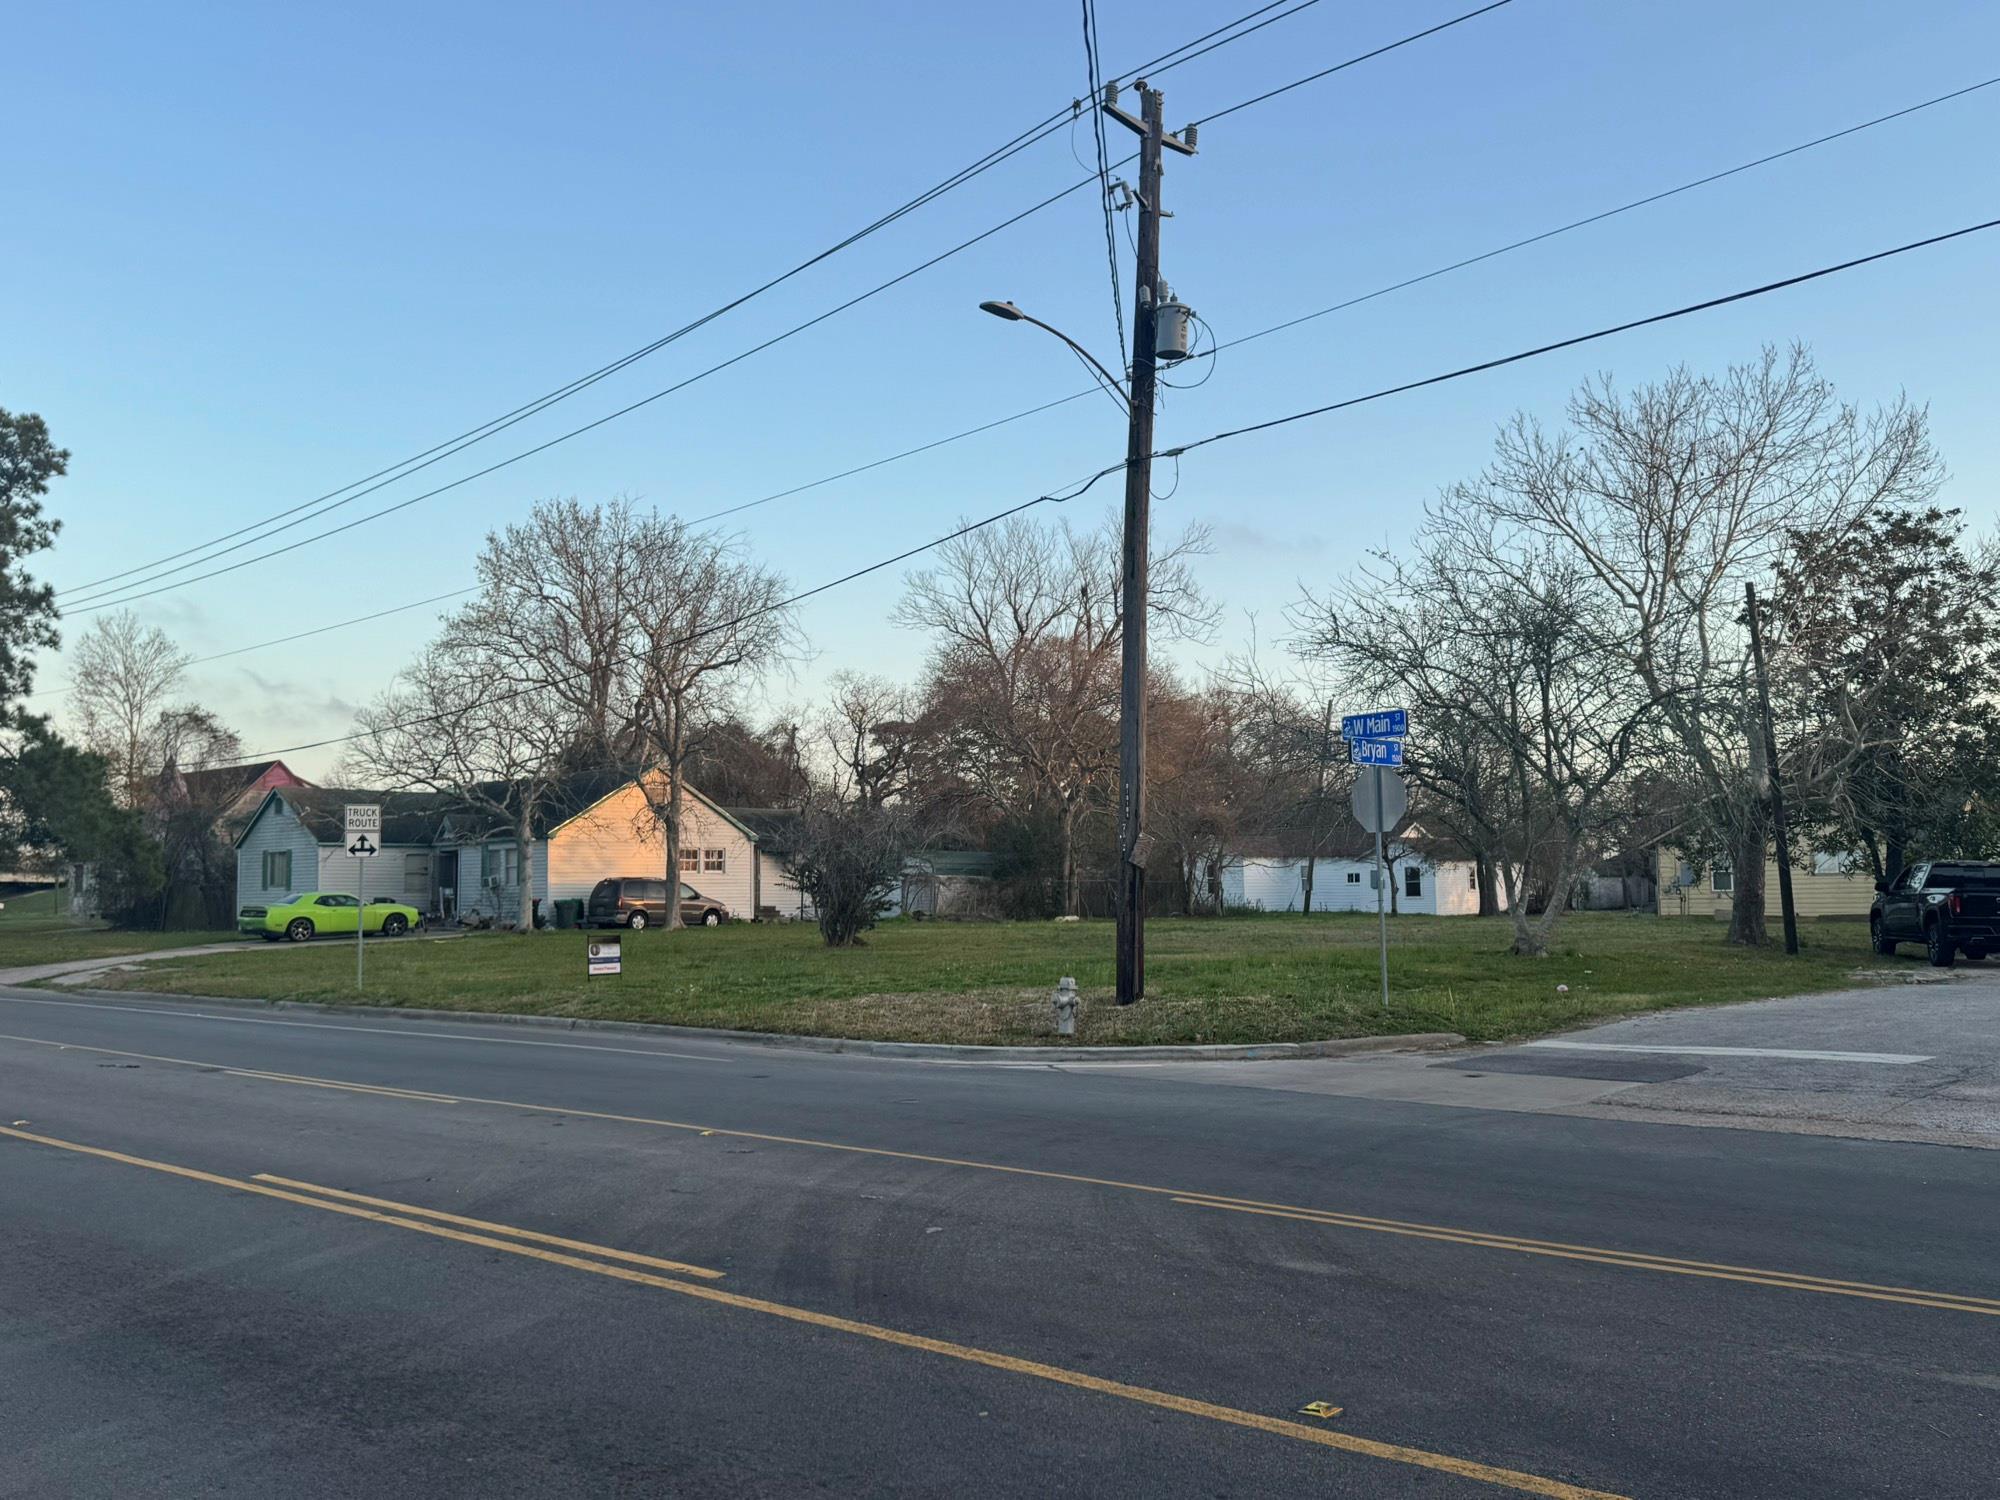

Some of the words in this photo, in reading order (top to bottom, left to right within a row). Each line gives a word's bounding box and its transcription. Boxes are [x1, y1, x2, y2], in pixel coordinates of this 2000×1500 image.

[1353, 718, 1364, 735] W
[1366, 714, 1391, 734] Main
[1362, 740, 1387, 762] Bryan
[348, 808, 378, 817] TRUCK
[348, 818, 378, 828] ROUTE
